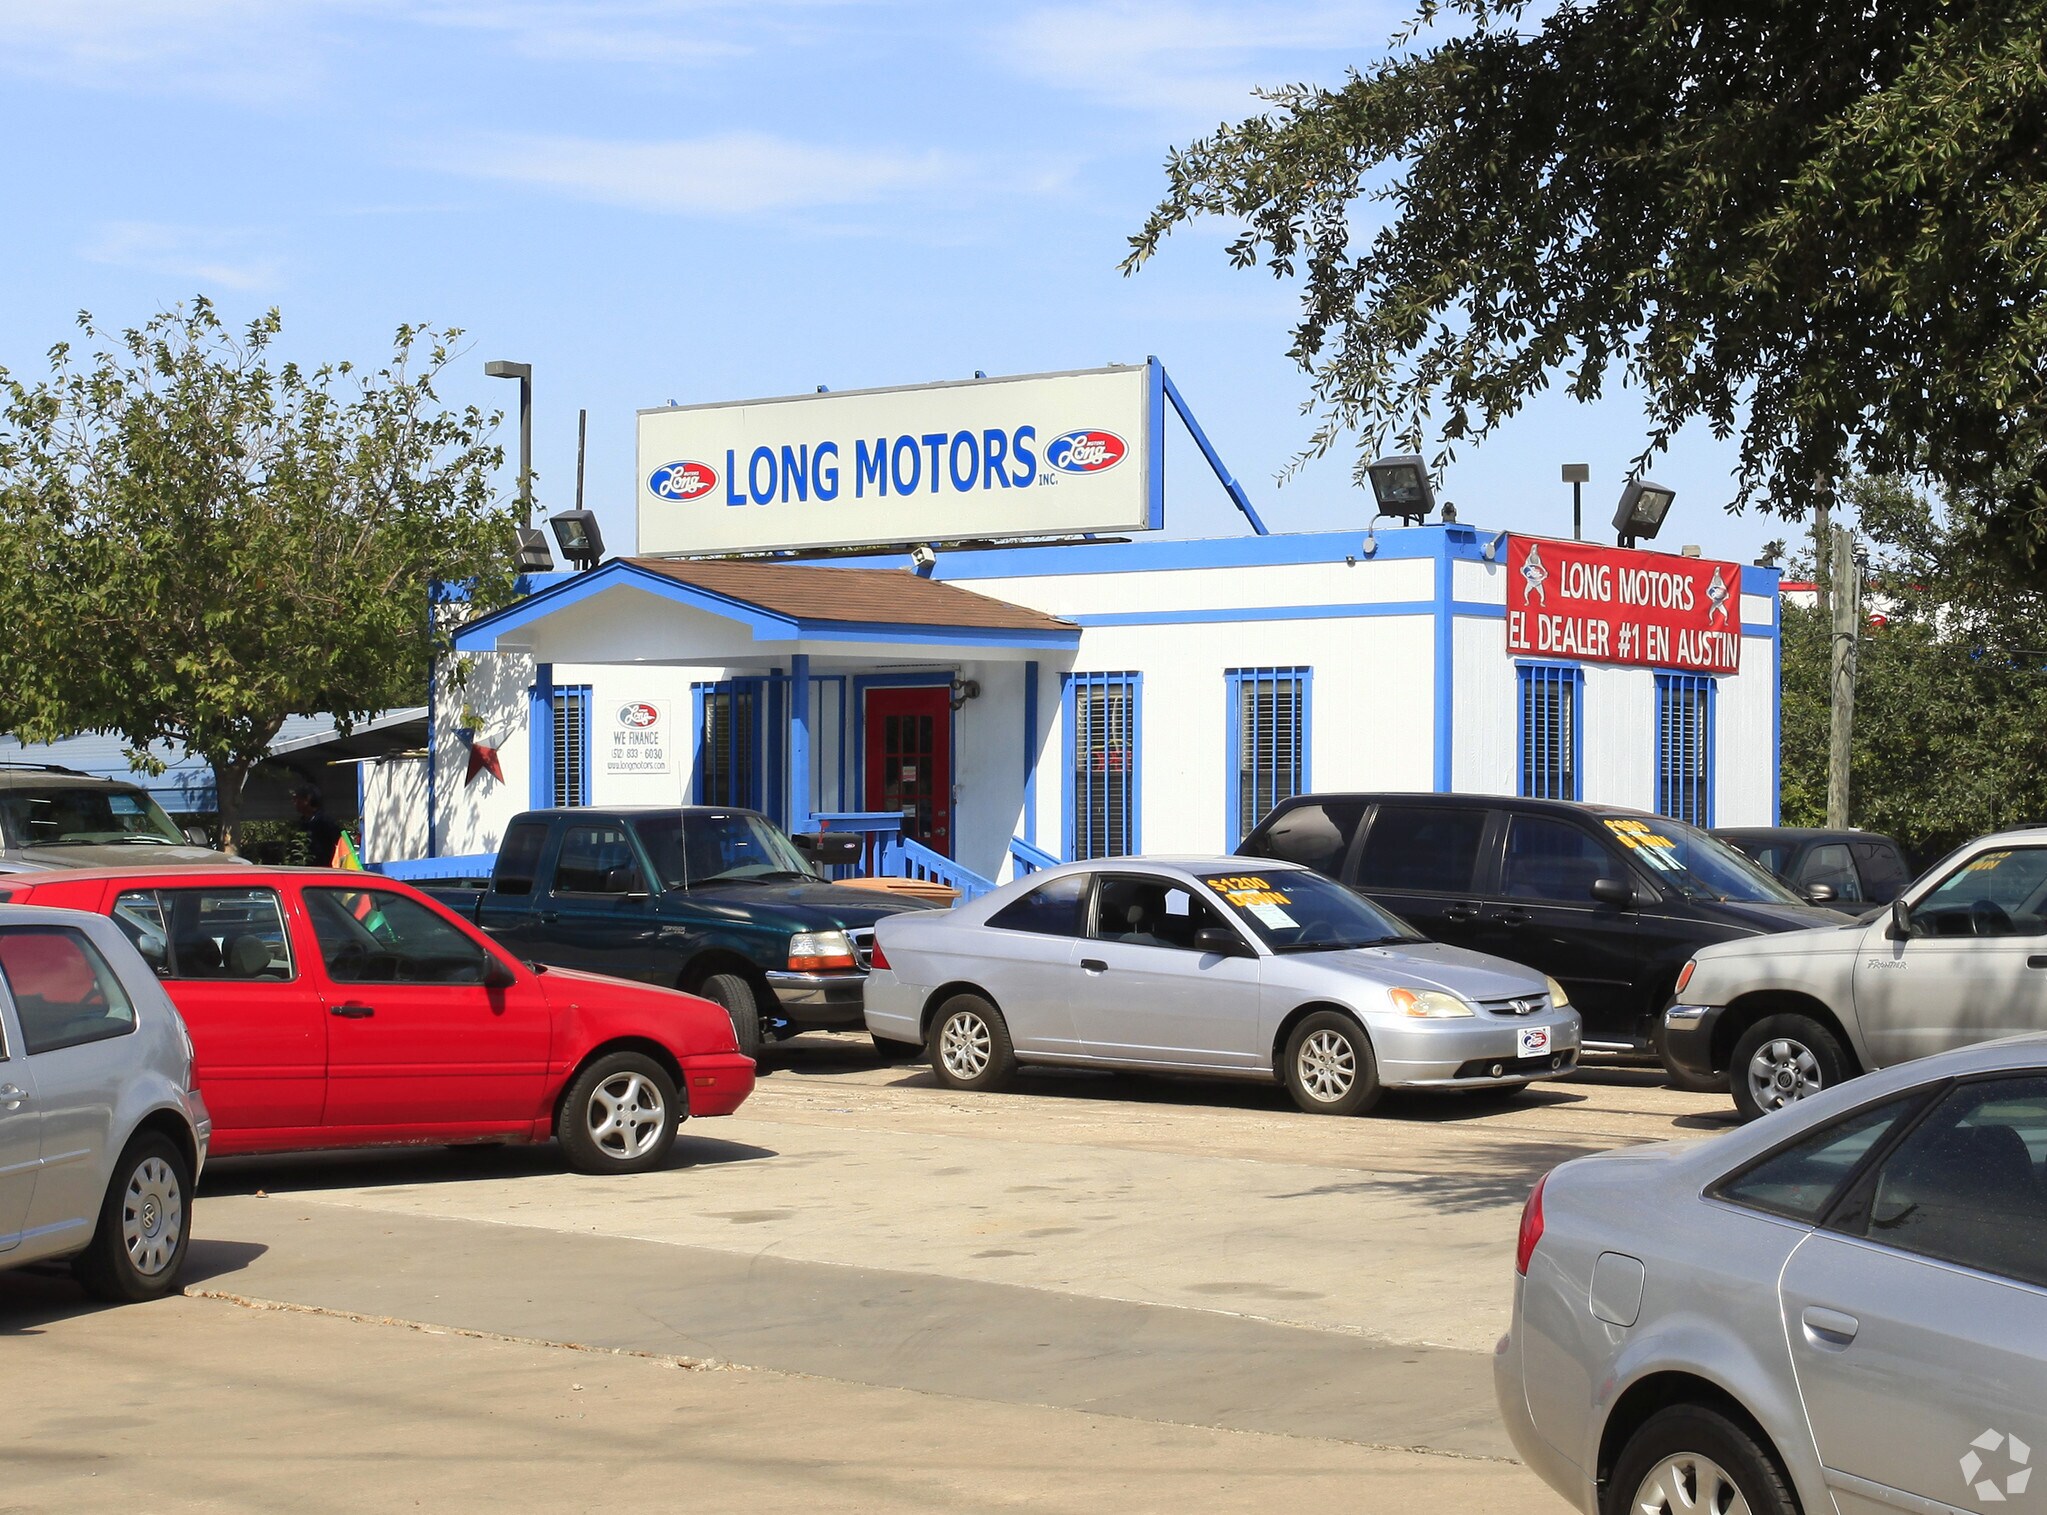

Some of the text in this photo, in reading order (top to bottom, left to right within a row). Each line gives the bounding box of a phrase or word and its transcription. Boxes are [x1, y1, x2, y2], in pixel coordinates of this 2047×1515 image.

[726, 425, 1059, 506] LONG MOTORS INC.
[1560, 560, 1695, 612] LONG MOTORS
[1509, 610, 1739, 668] EL DEALER #1 EN AUSTIN
[613, 731, 659, 745] WE FINANCE
[626, 748, 639, 759] 833
[644, 748, 663, 760] 6030
[1207, 876, 1271, 893] $1200
[1224, 891, 1292, 907] DOWN
